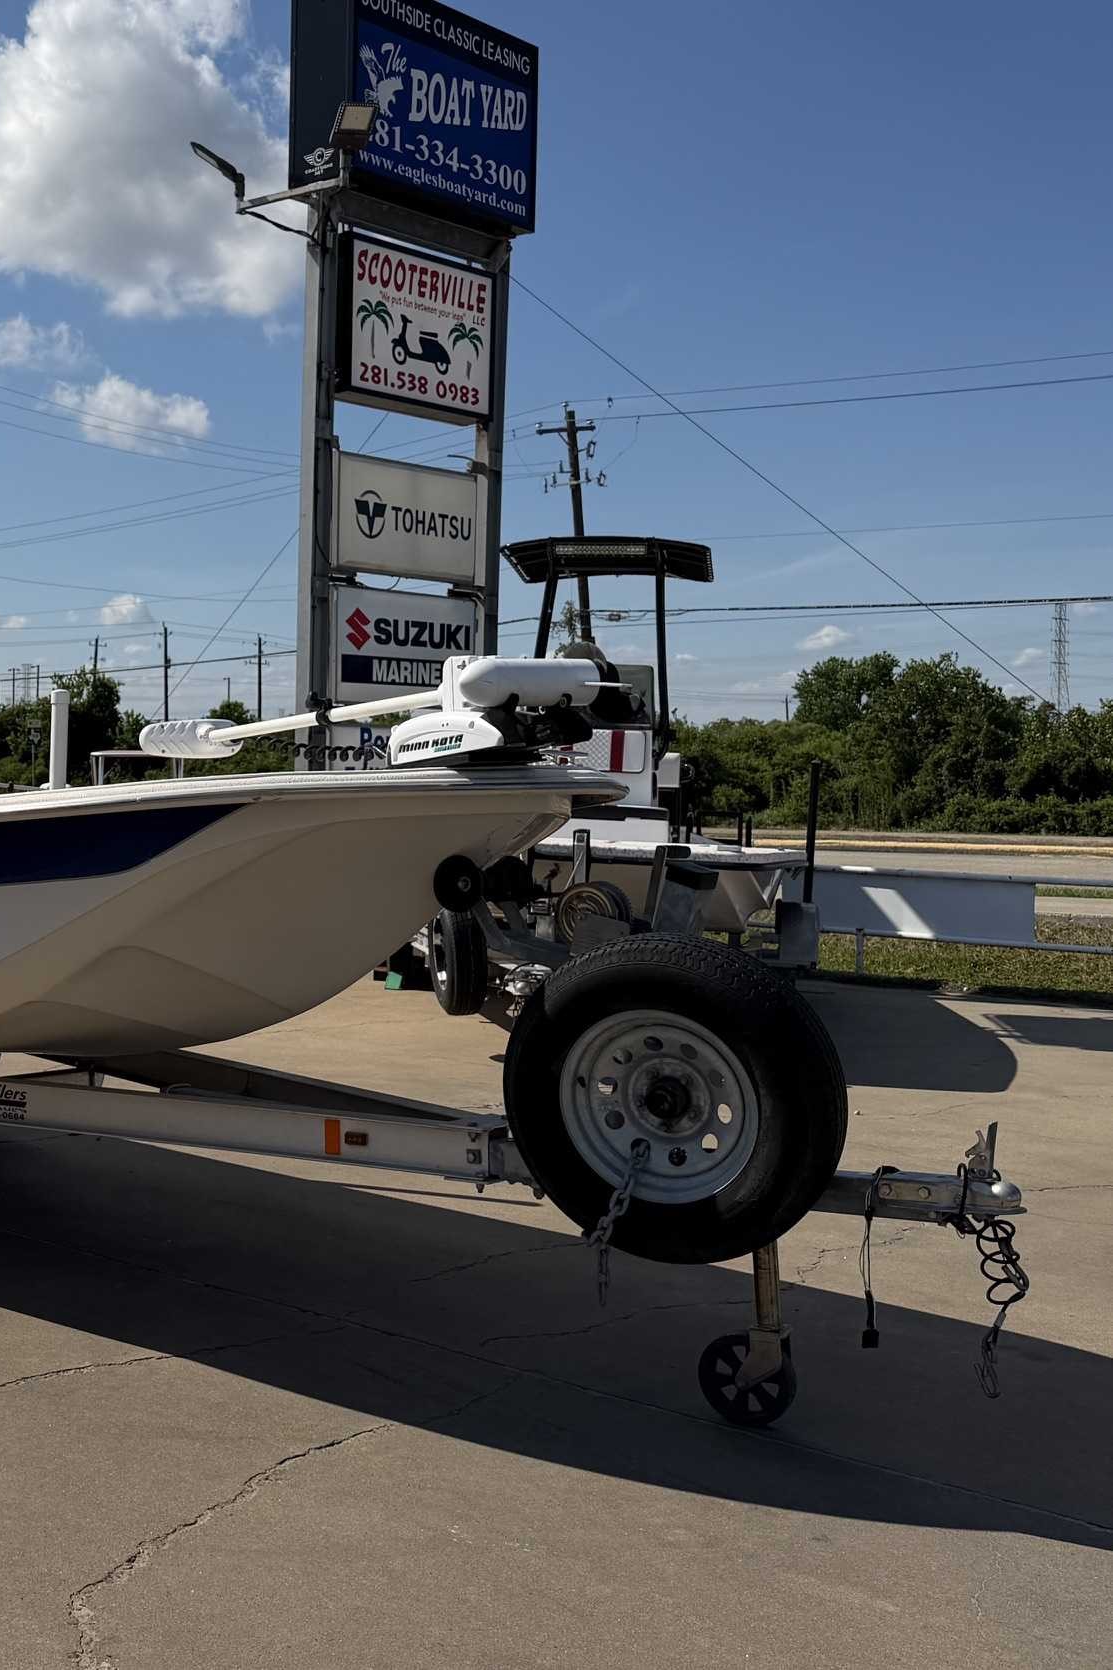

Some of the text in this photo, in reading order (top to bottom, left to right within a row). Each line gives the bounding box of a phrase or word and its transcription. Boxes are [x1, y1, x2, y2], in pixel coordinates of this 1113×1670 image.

[381, 43, 407, 74] The
[434, 18, 480, 55] CLASSIC
[482, 39, 530, 75] LEASING
[408, 68, 527, 131] BOAT YARD
[368, 118, 527, 195] 81-334-3300
[359, 149, 527, 217] www.eaglesboatyard.com
[357, 250, 486, 314] SCOOTERVILLE
[472, 315, 486, 327] LLC
[359, 362, 480, 406] 281.538 0983
[391, 506, 471, 541] TOHATSU
[374, 618, 471, 651] SUZUKI
[372, 658, 441, 685] MARINE
